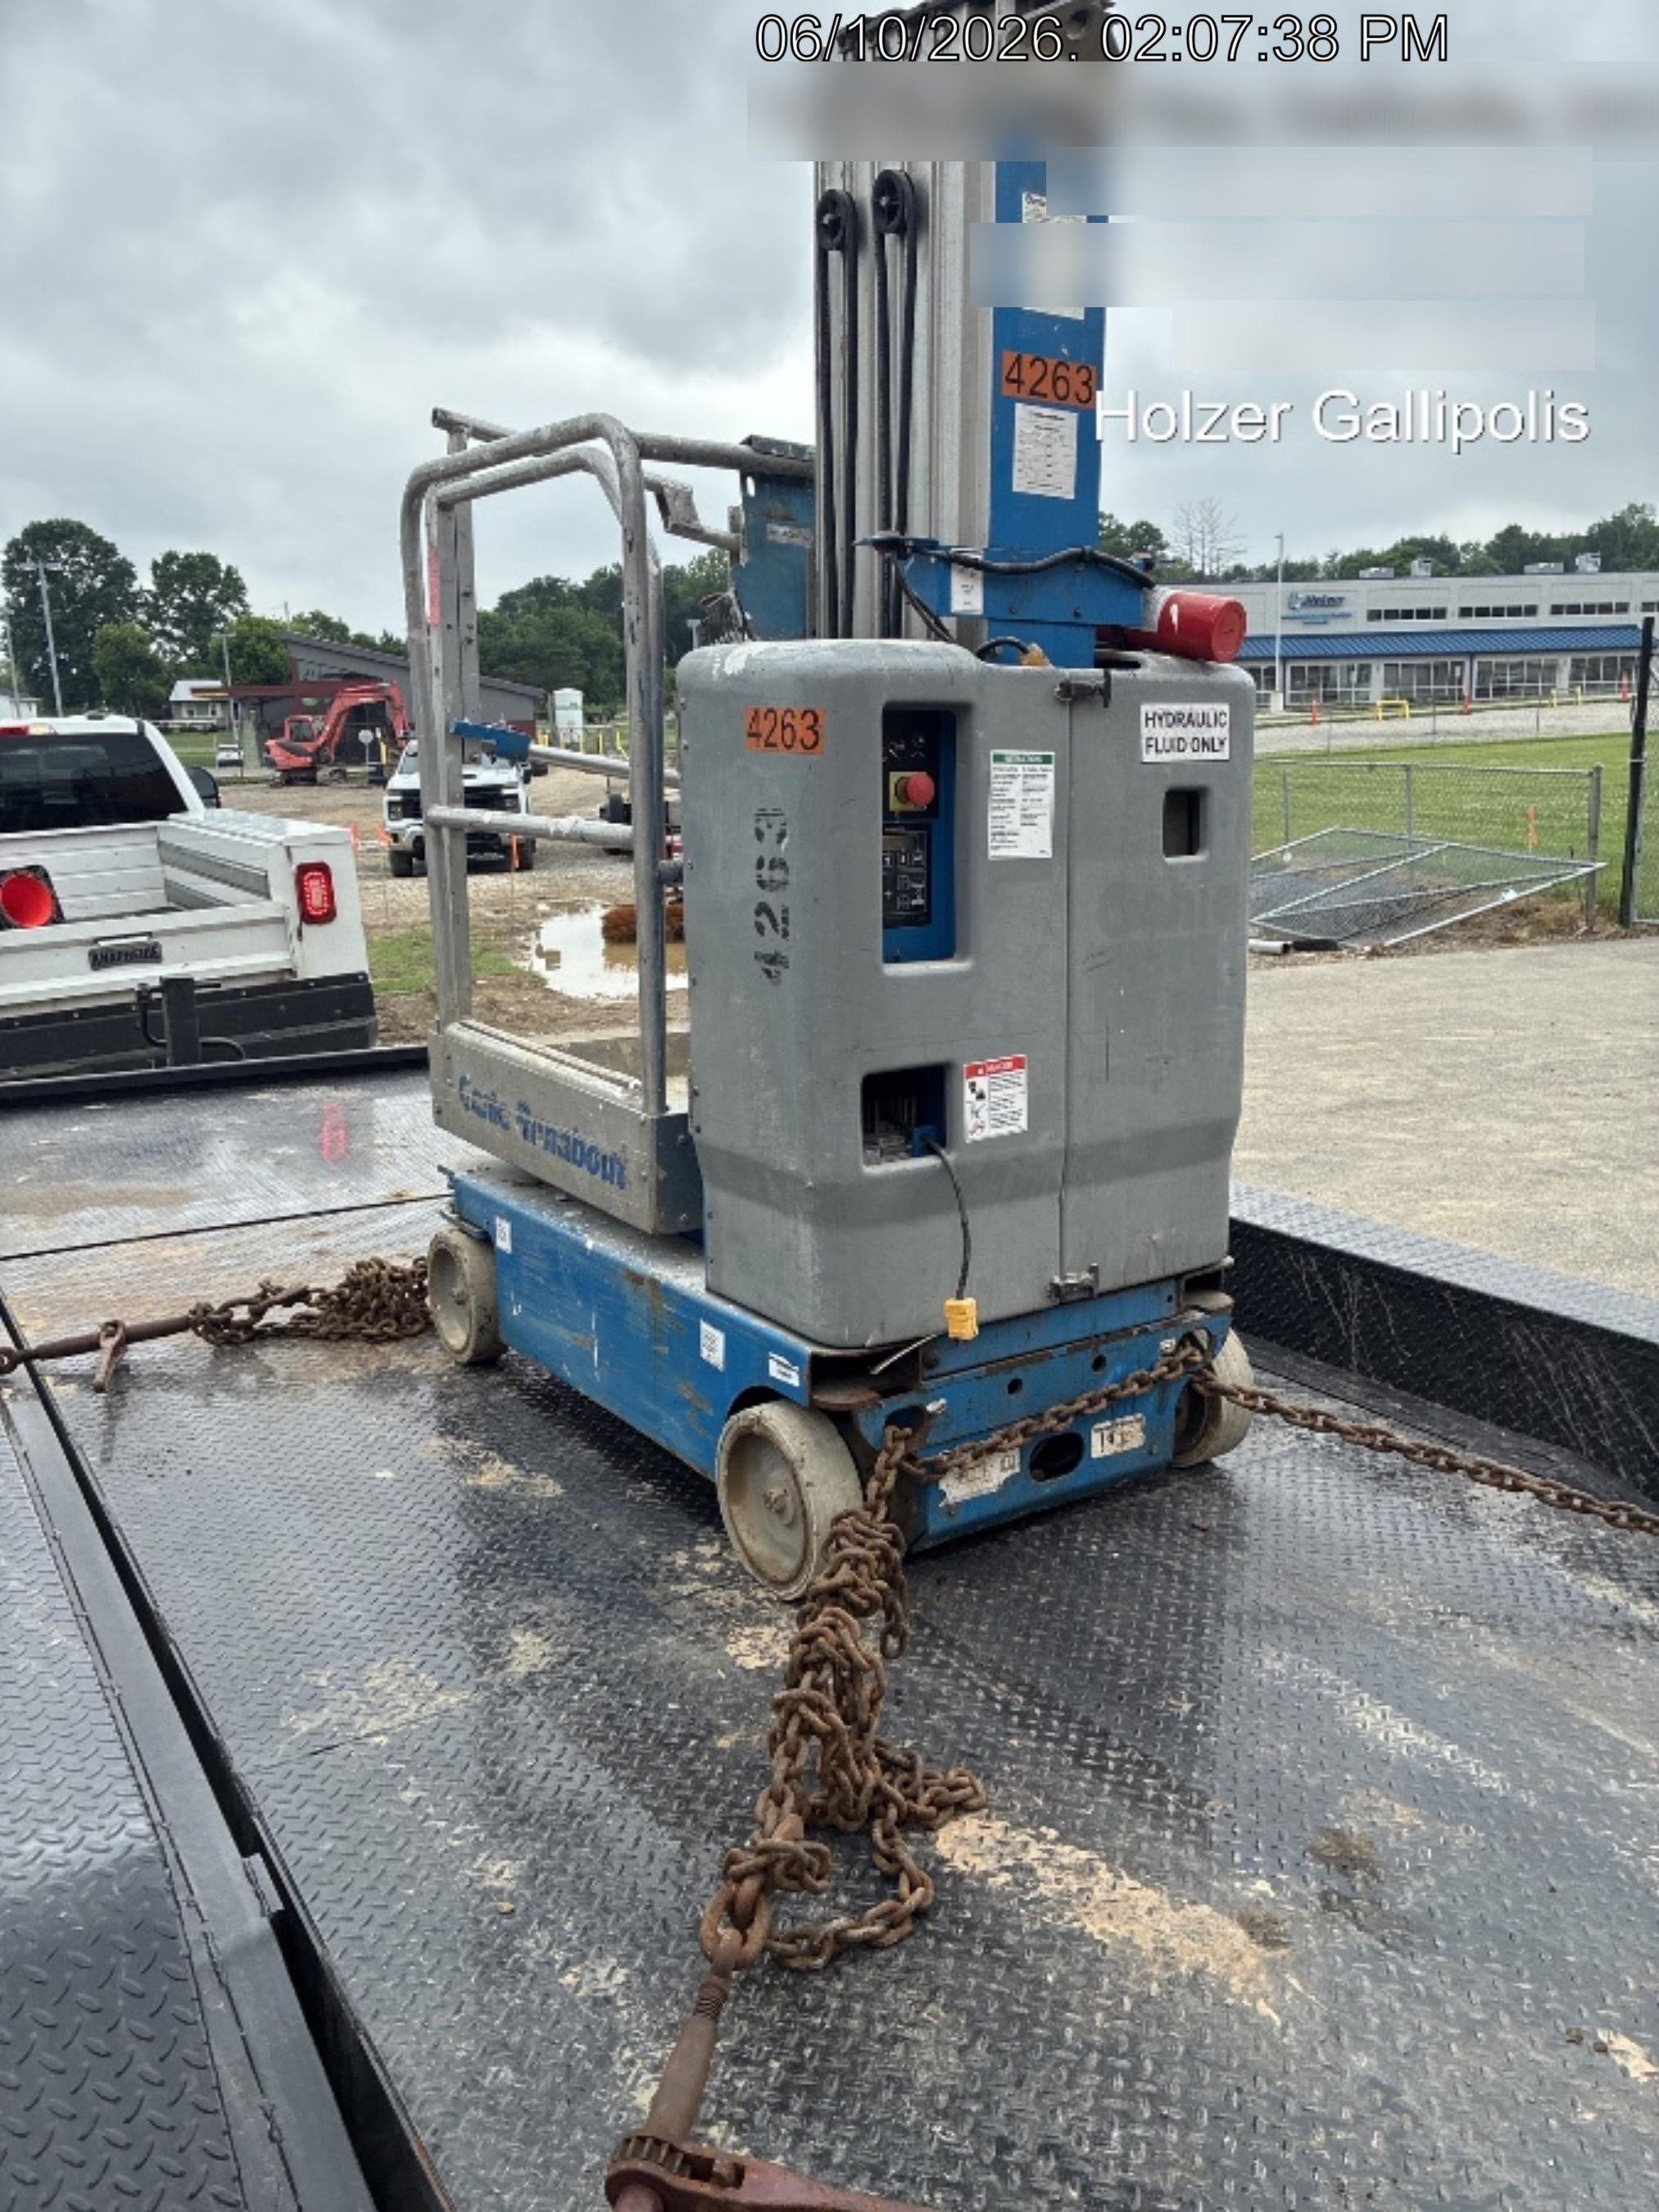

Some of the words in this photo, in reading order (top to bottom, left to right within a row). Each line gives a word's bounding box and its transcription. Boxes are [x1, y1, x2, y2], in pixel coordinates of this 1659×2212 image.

[1004, 353, 1094, 404] 4263
[746, 707, 820, 750] 4263
[1145, 710, 1228, 729] HYDRAULIC
[1145, 736, 1187, 755] FLUID
[1191, 736, 1227, 753] ONLY
[753, 807, 790, 986] 4263
